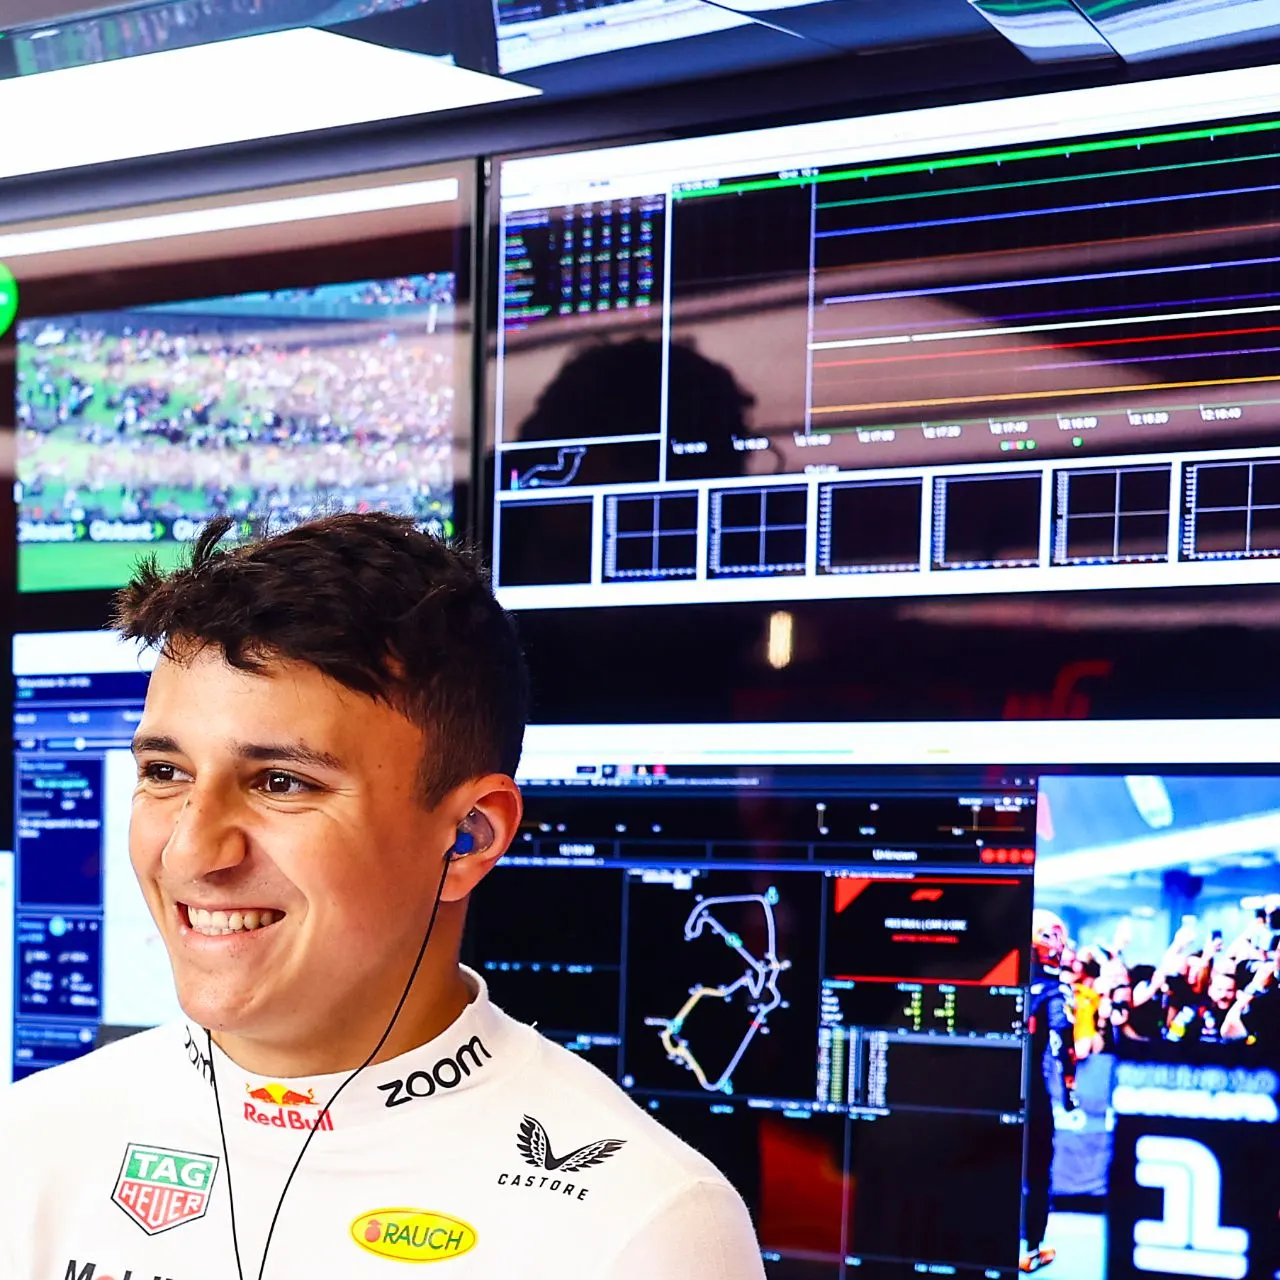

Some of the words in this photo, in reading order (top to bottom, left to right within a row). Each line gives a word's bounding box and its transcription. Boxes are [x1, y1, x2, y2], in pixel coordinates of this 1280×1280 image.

[377, 1035, 492, 1108] zoom
[243, 1102, 287, 1129] Red
[287, 1108, 334, 1132] Bull
[133, 1151, 208, 1188] TAG
[497, 1173, 589, 1201] CASTORE
[120, 1182, 203, 1229] HEUER
[383, 1222, 465, 1252] RAUCH
